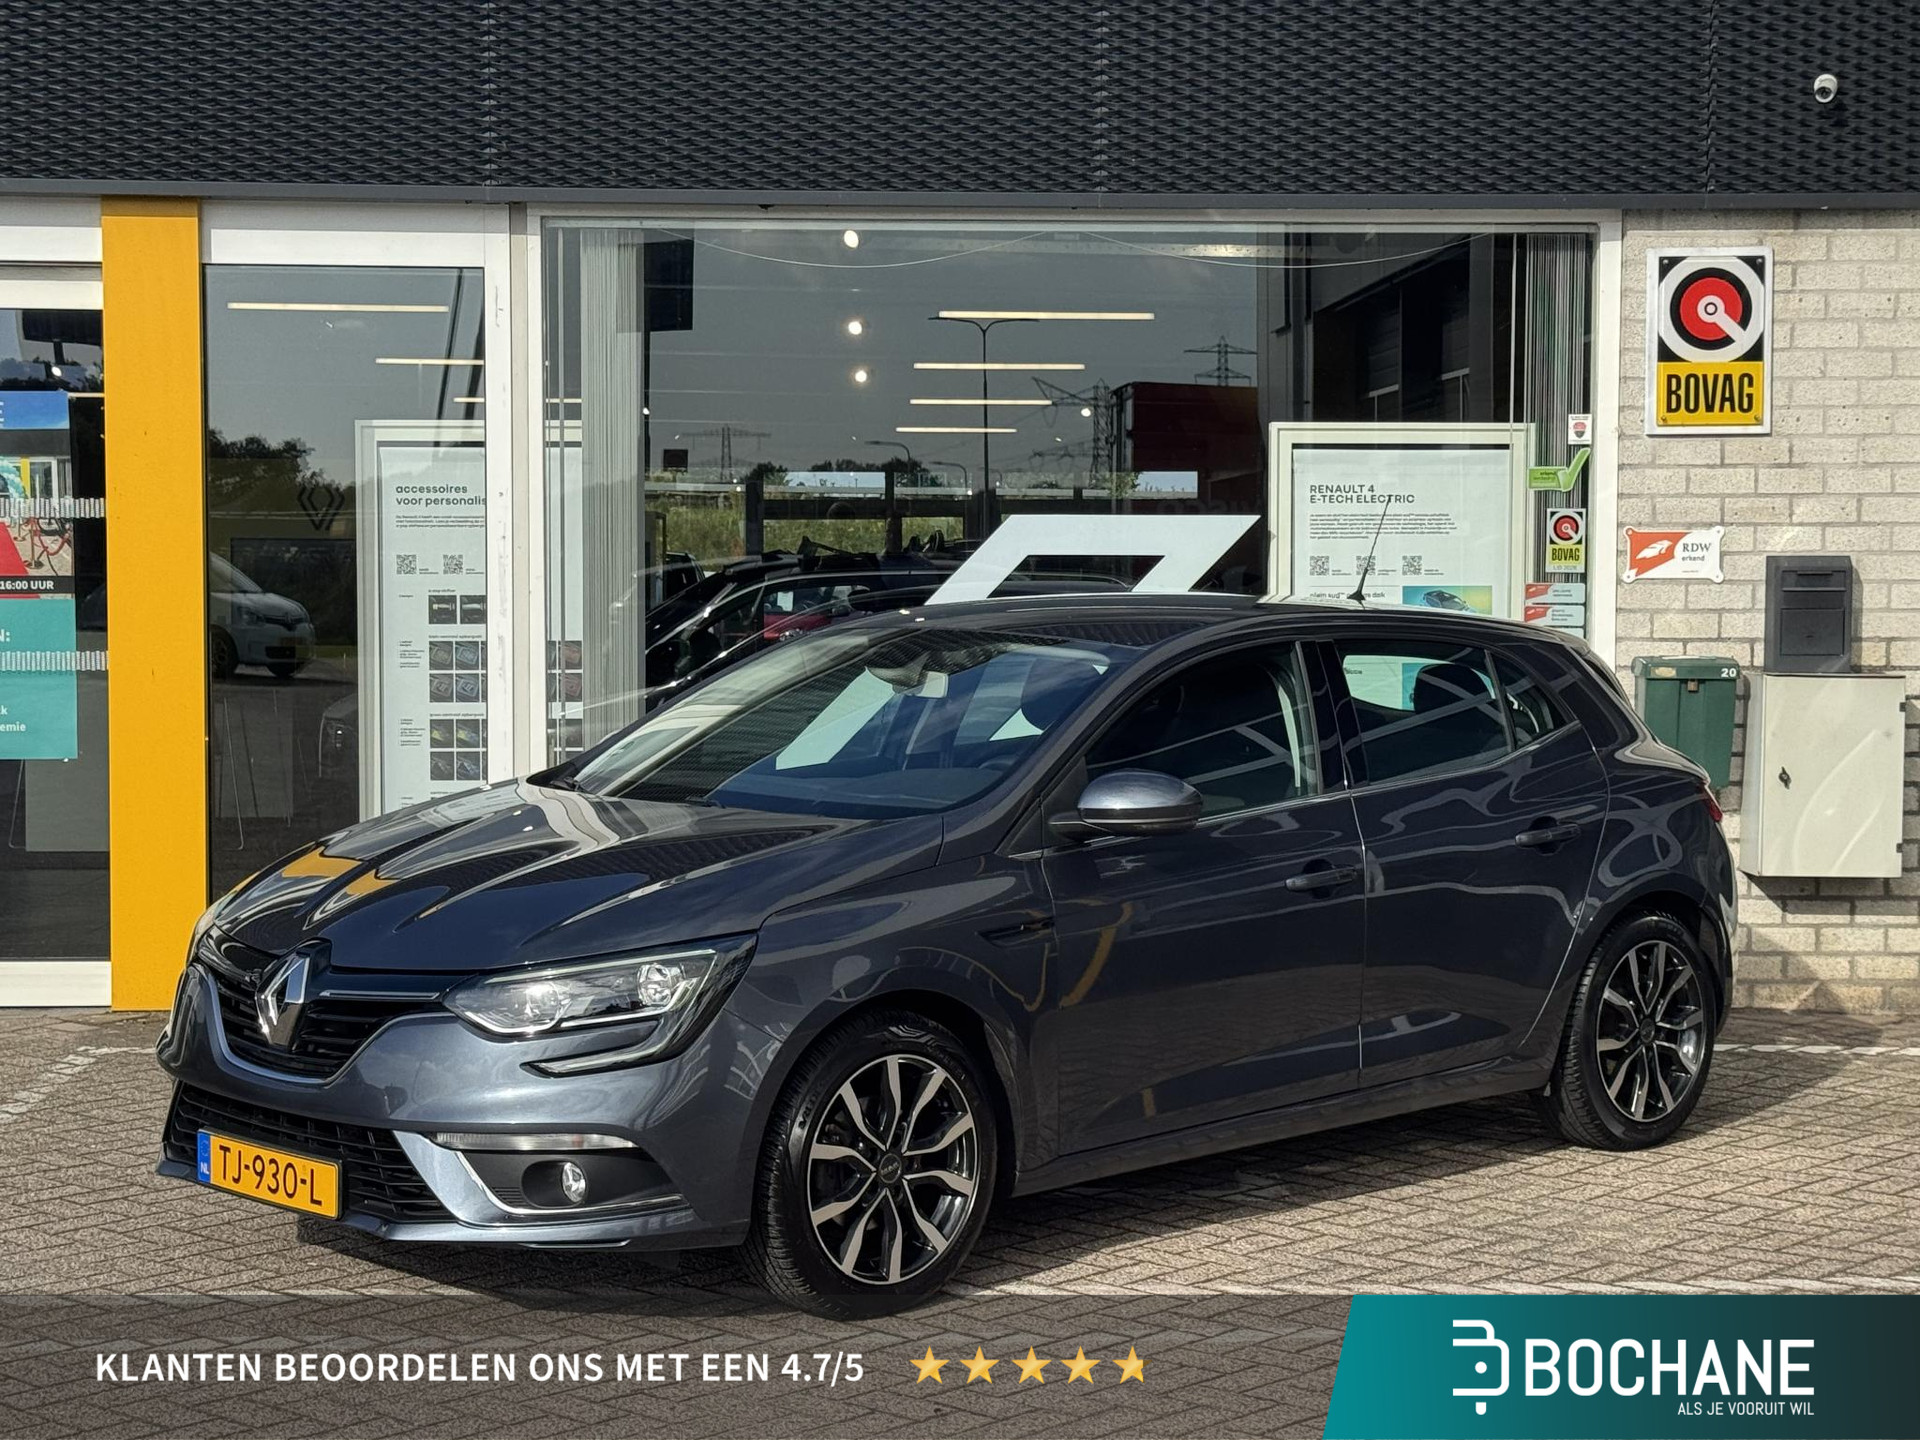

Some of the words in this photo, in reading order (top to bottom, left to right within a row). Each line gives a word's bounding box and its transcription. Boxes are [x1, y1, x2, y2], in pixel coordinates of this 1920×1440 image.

[1666, 373, 1755, 414] BOVAG
[396, 484, 468, 494] accessoires
[1310, 484, 1365, 494] RENAULT
[1367, 484, 1375, 494] 4
[396, 497, 423, 506] voor
[1310, 494, 1354, 504] E-TECH
[1356, 494, 1415, 504] ELECTRIC
[1682, 542, 1712, 553] RDW
[1551, 547, 1581, 562] BOVAG
[0, 580, 29, 590] 16:00
[30, 580, 55, 590] UUR
[1720, 667, 1737, 678] 20
[200, 1161, 210, 1175] NL
[219, 1144, 322, 1207] TJ-930-L
